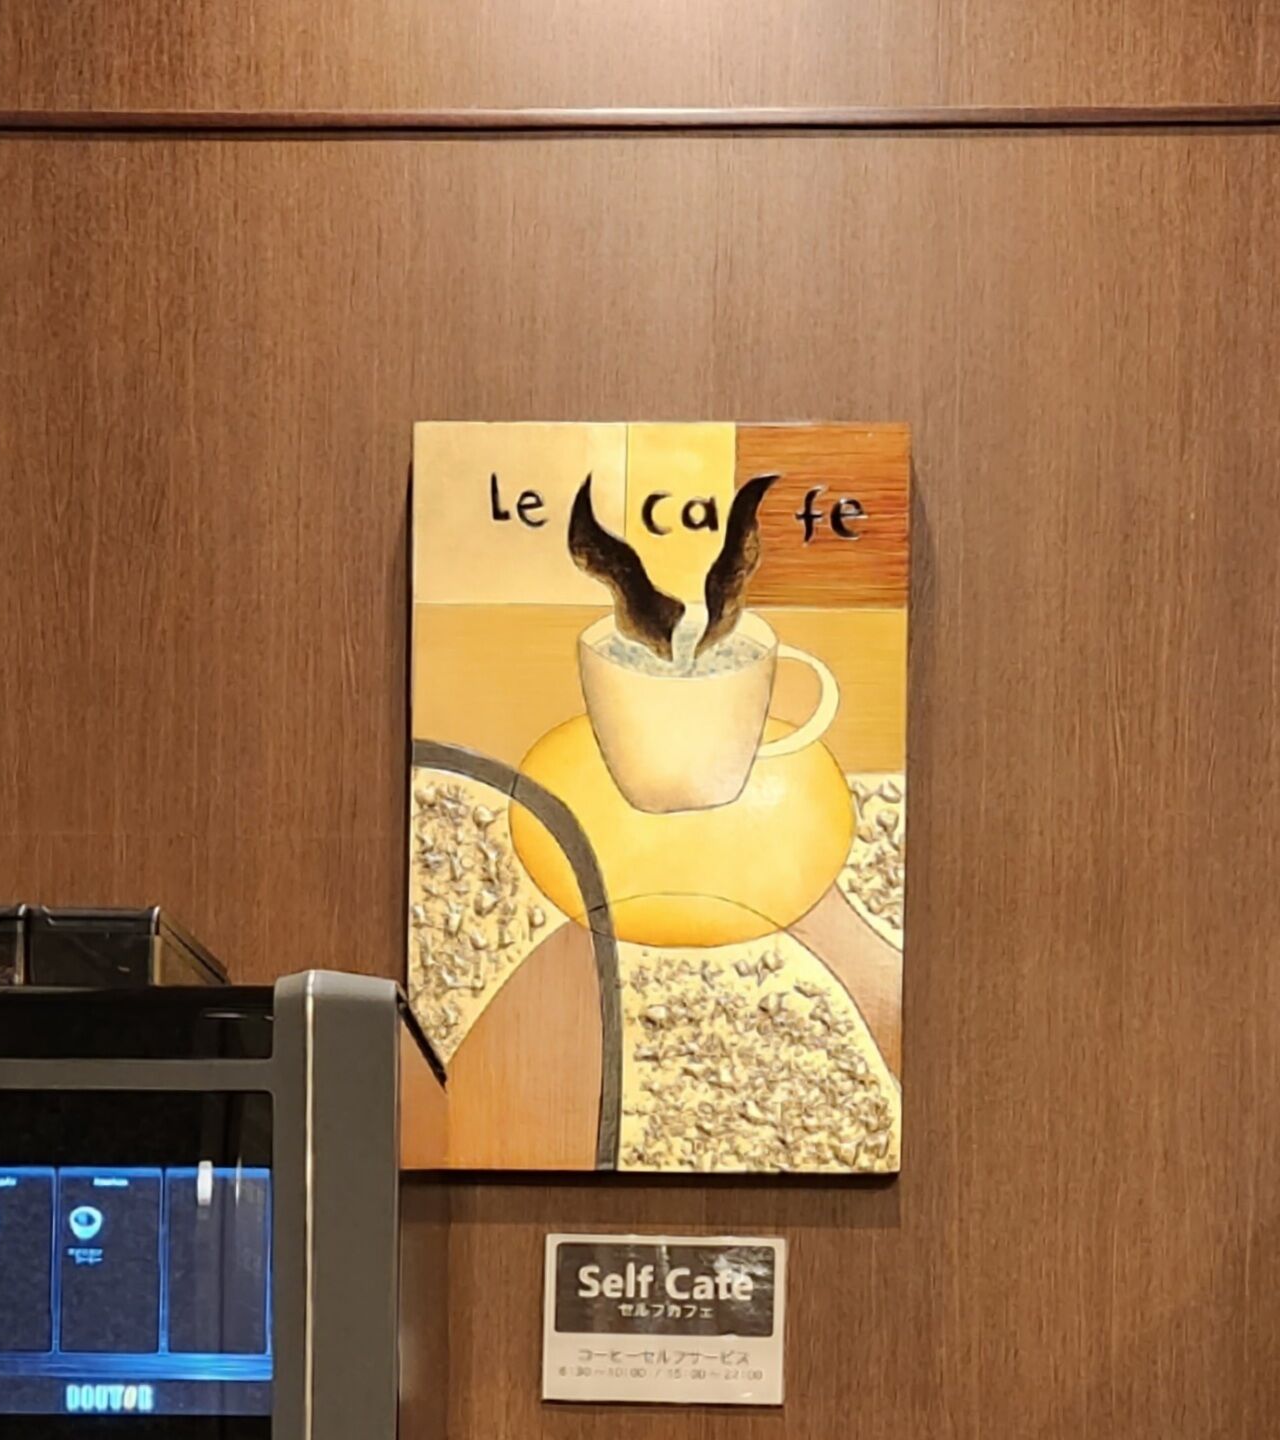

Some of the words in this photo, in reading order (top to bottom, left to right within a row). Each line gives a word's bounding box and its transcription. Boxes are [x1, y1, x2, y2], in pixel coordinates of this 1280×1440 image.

[577, 1261, 655, 1299] Self
[617, 1303, 714, 1319] セルフカフェ
